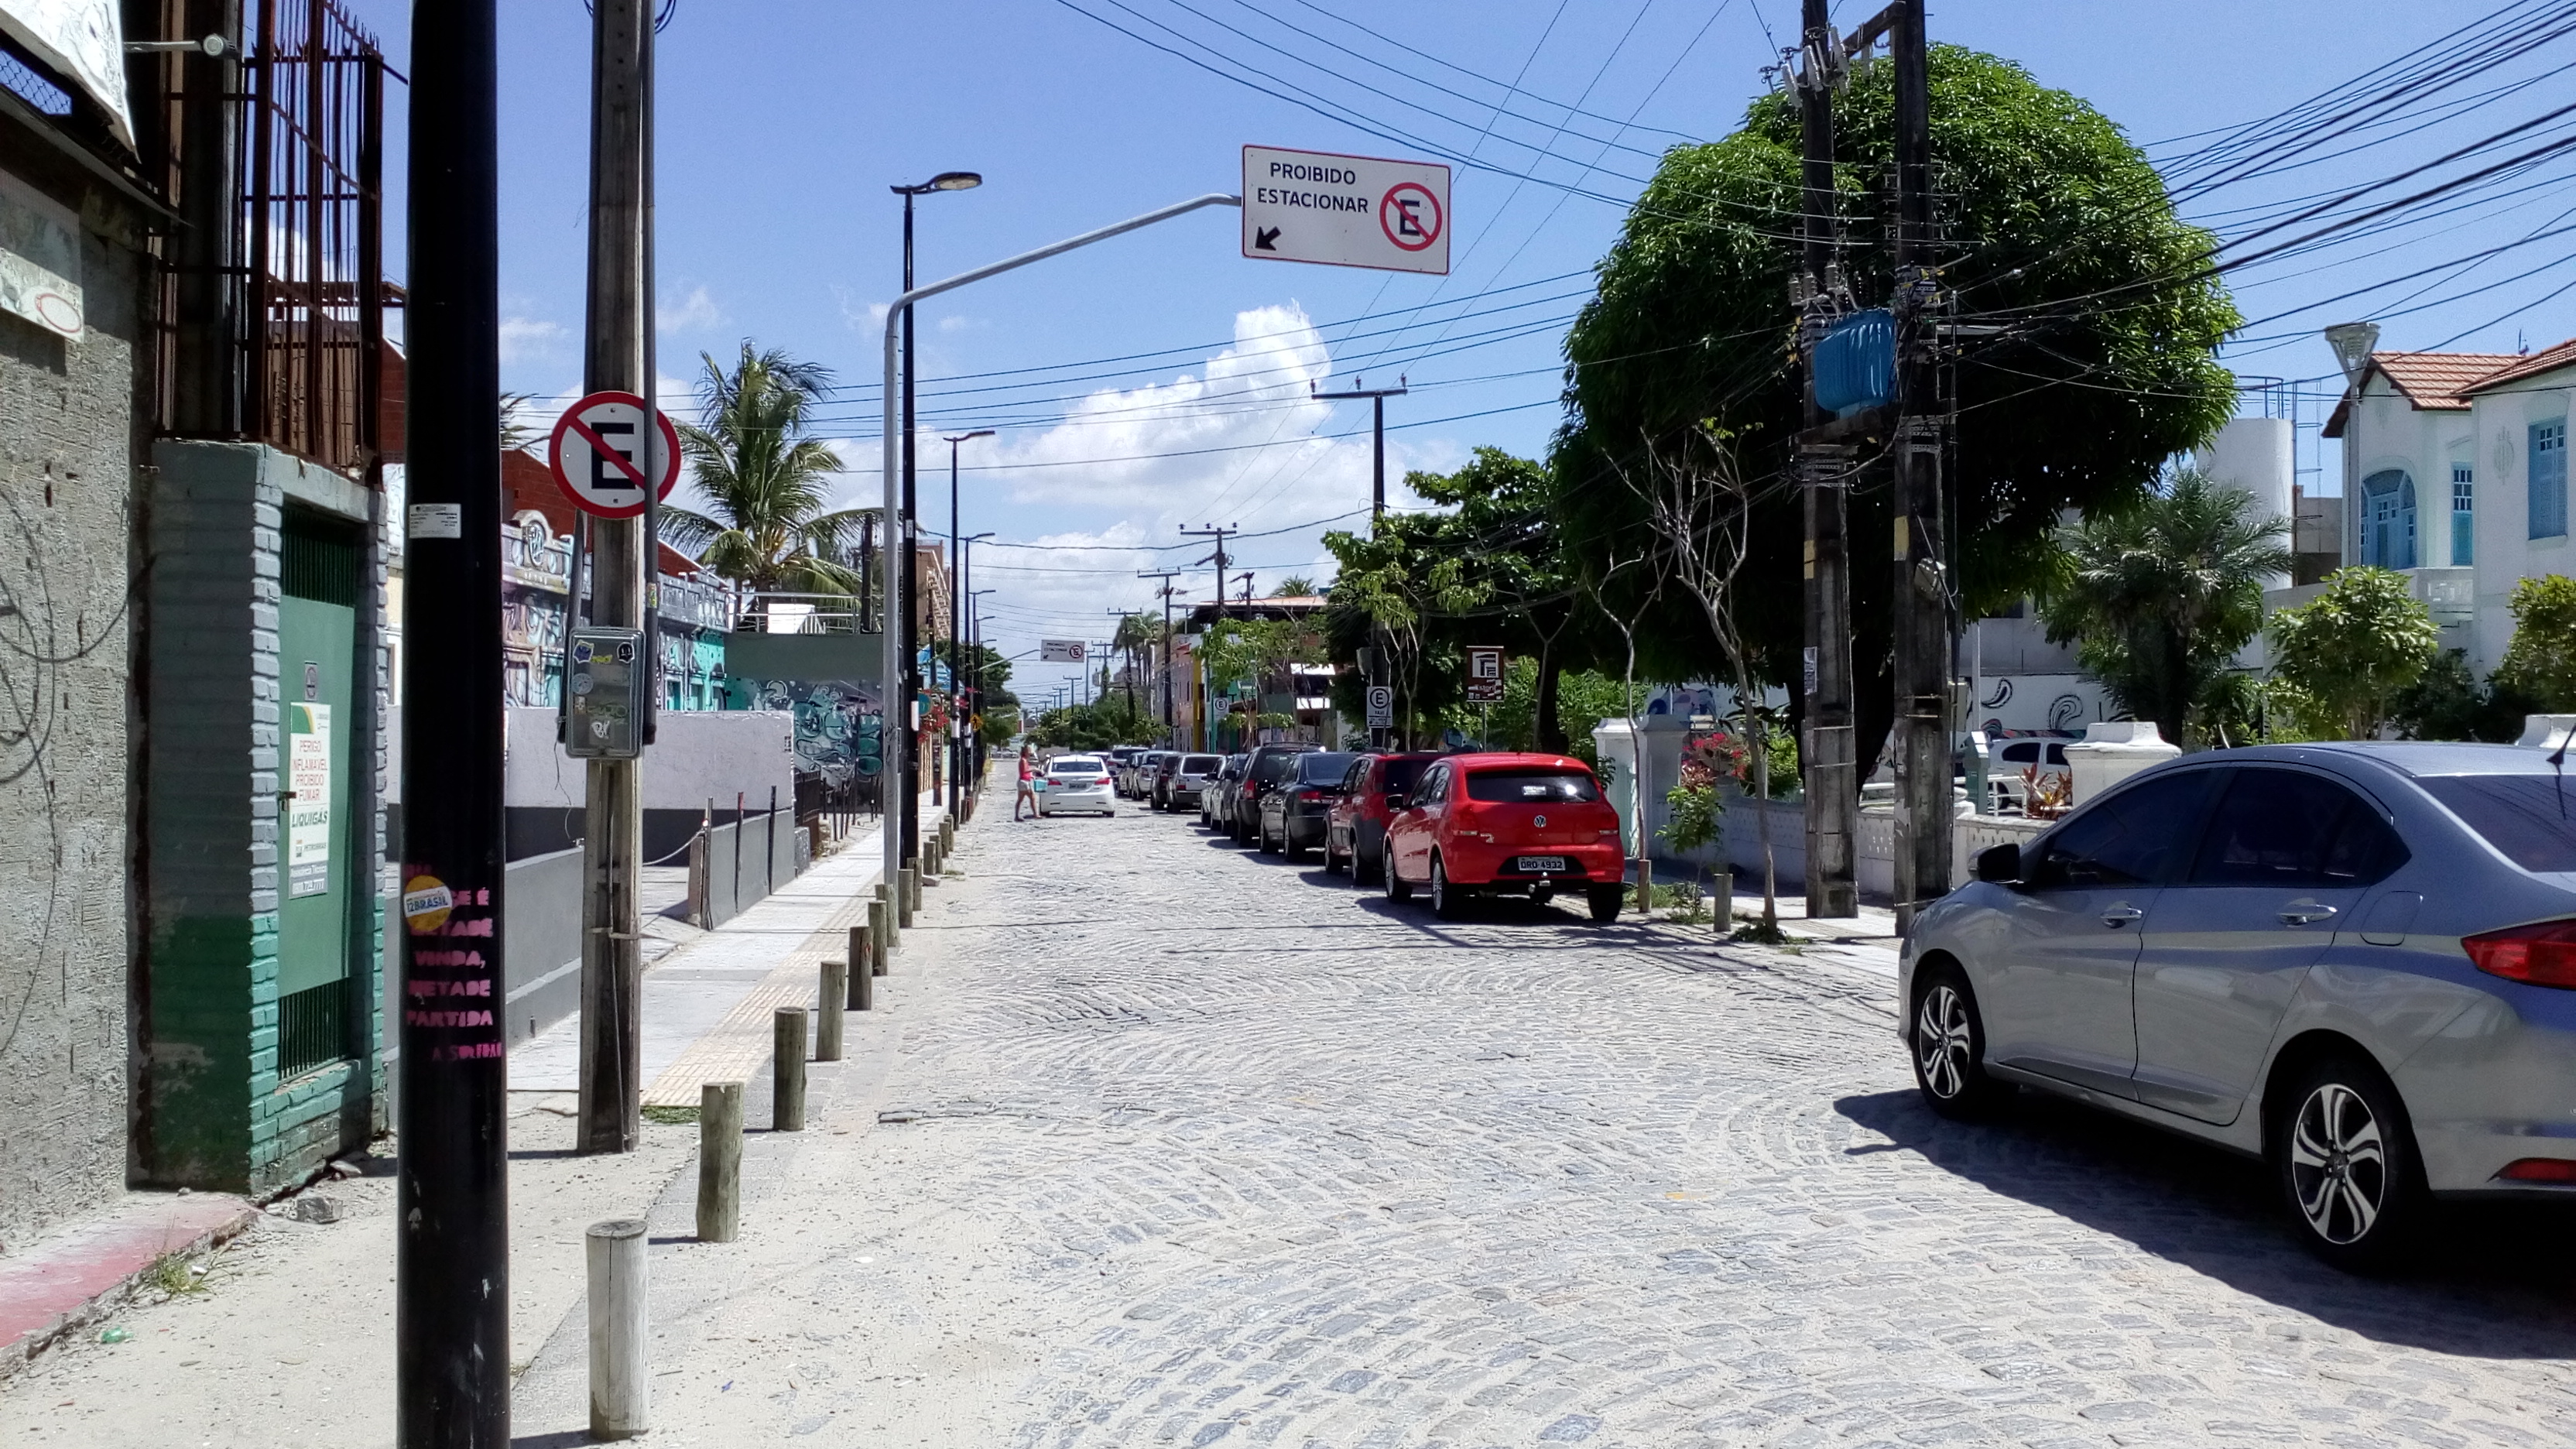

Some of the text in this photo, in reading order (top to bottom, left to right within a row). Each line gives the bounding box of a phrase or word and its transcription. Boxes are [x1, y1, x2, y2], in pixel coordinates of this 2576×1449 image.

[1270, 162, 1355, 185] PROIBIDO
[1257, 187, 1368, 214] ESTACIONAR
[1375, 692, 1384, 704] E
[299, 739, 322, 753] PERIGO
[296, 774, 324, 786] PROIBIDO
[299, 788, 320, 803] FUMAR
[291, 807, 328, 828] LIQUIGÁS
[406, 1009, 494, 1028] PARTIDA
